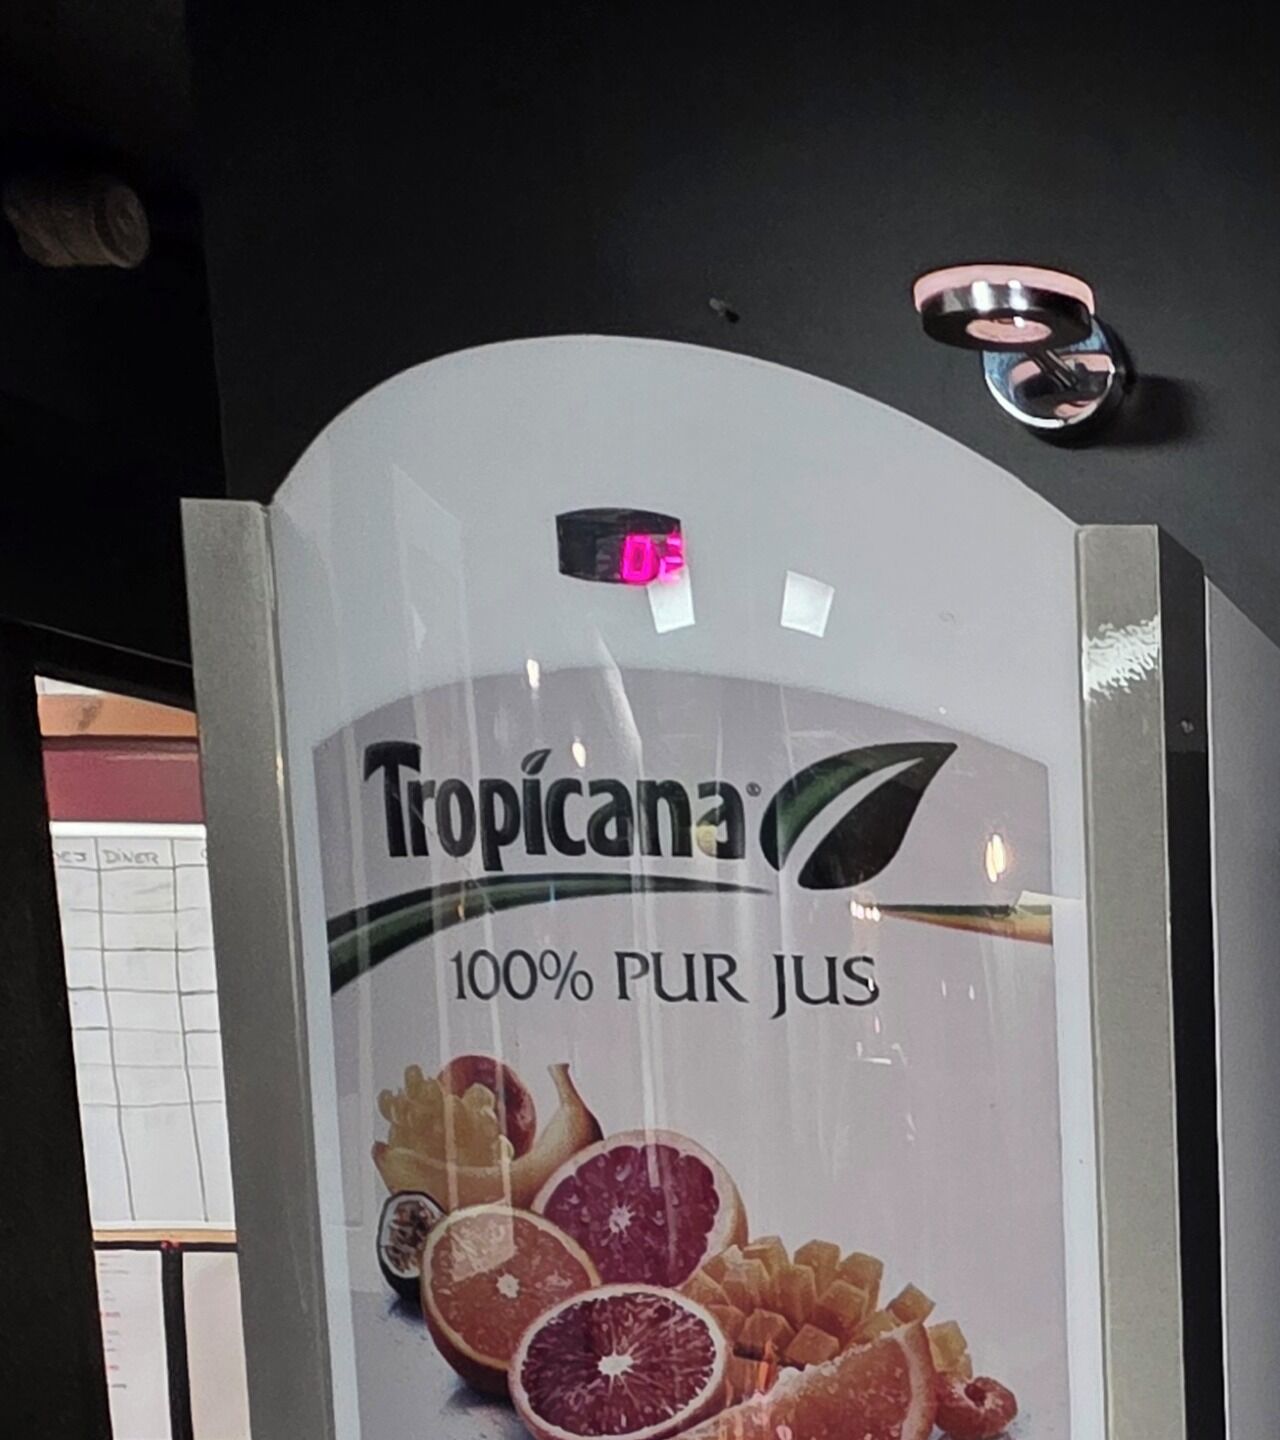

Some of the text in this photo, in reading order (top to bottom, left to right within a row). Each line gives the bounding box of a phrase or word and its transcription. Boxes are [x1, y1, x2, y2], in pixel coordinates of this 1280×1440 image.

[364, 741, 746, 871] Tropicana
[449, 948, 880, 1019] 100% PUR JUS
